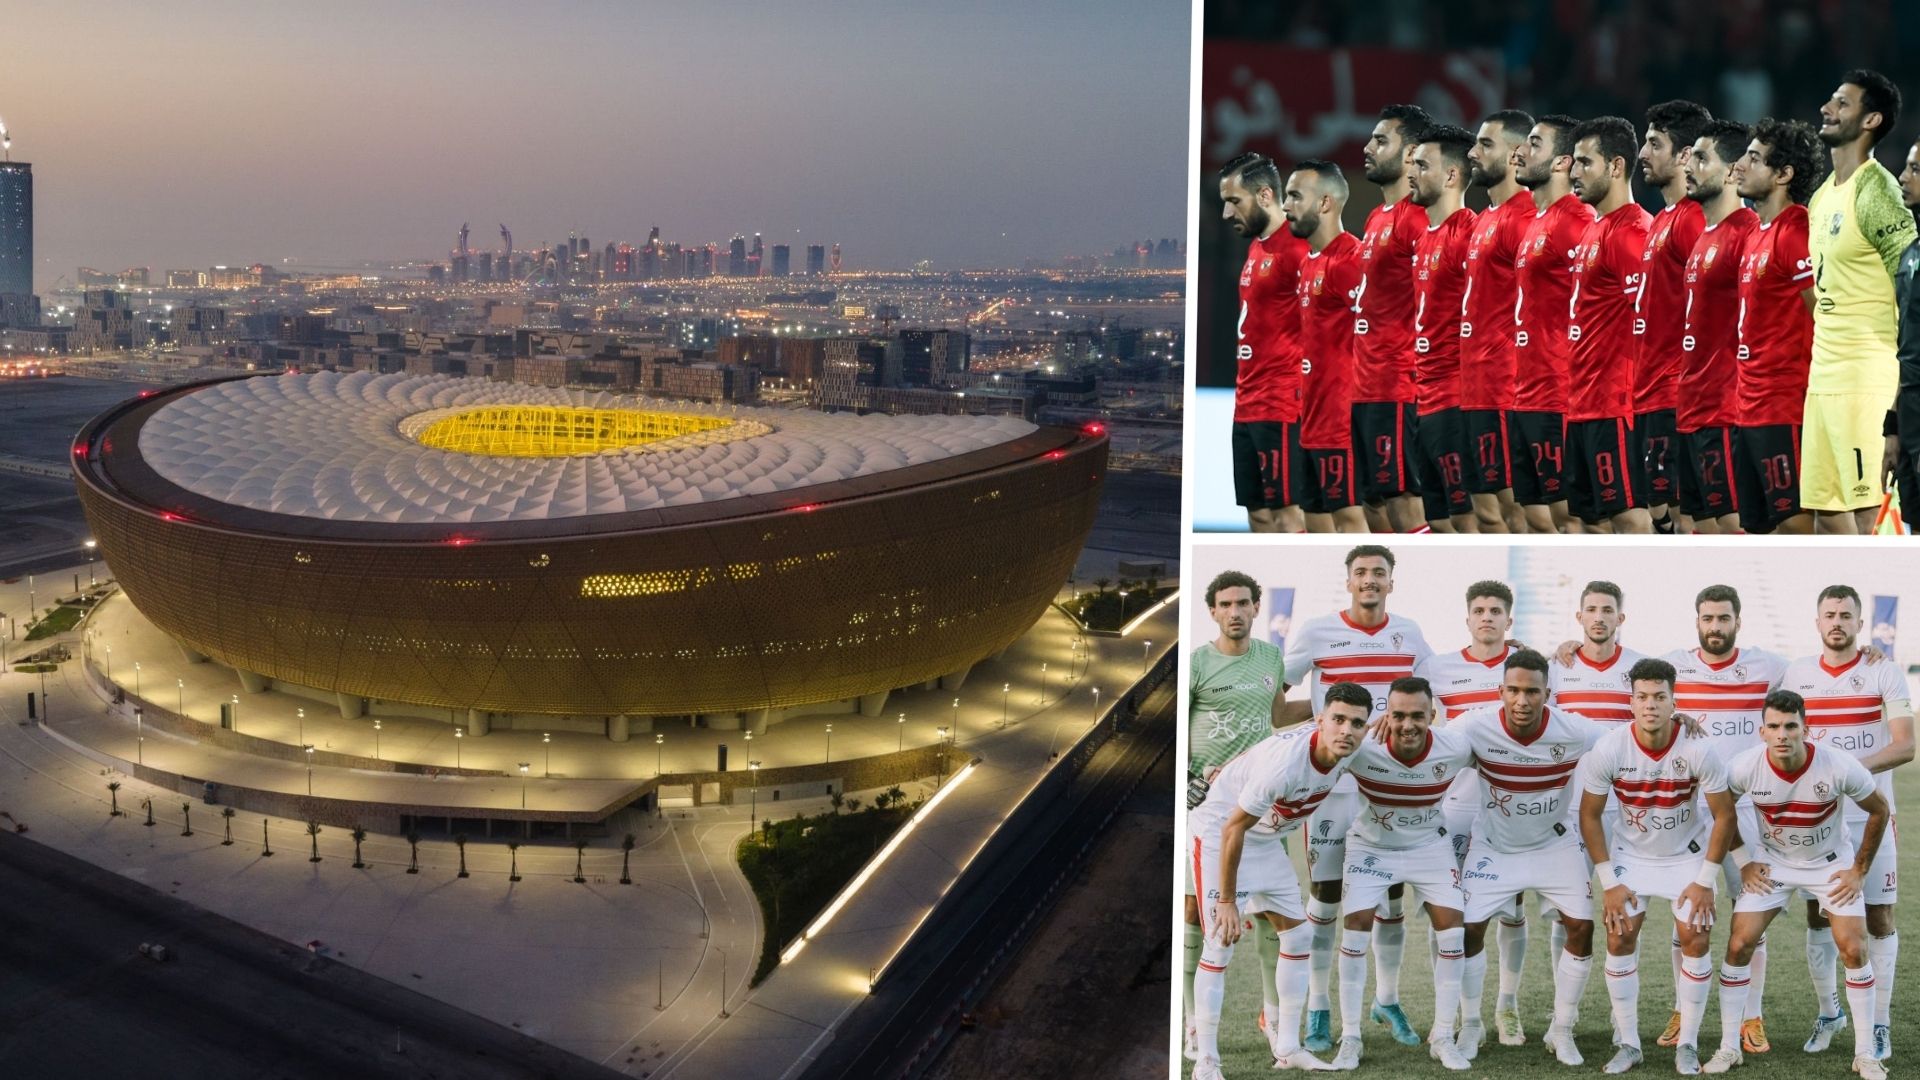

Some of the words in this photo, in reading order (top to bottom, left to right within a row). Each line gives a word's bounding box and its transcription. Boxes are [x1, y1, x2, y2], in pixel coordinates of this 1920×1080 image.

[1375, 434, 1392, 468] 9
[1477, 431, 1497, 468] 17
[1531, 440, 1563, 476] 24
[1319, 454, 1344, 489] 19
[1595, 451, 1615, 486] 8
[1761, 453, 1793, 495] 30
[1853, 447, 1864, 481] 1
[1330, 640, 1351, 649] tempo
[1212, 684, 1233, 694] tempo
[1240, 711, 1270, 733] sai
[1711, 715, 1755, 737] saib
[1831, 730, 1875, 751] saib
[1487, 747, 1509, 756] tempo
[1512, 754, 1541, 764] oppo
[1367, 764, 1390, 775] tempo
[1751, 789, 1772, 797] tempo
[1515, 796, 1560, 817] saib
[1396, 808, 1441, 828] saib
[1651, 807, 1691, 831] saib
[1788, 825, 1832, 848] saib
[1346, 864, 1394, 881] EGYPTAIR
[1463, 870, 1500, 881] EGYPTAI
[1885, 872, 1897, 888] 28
